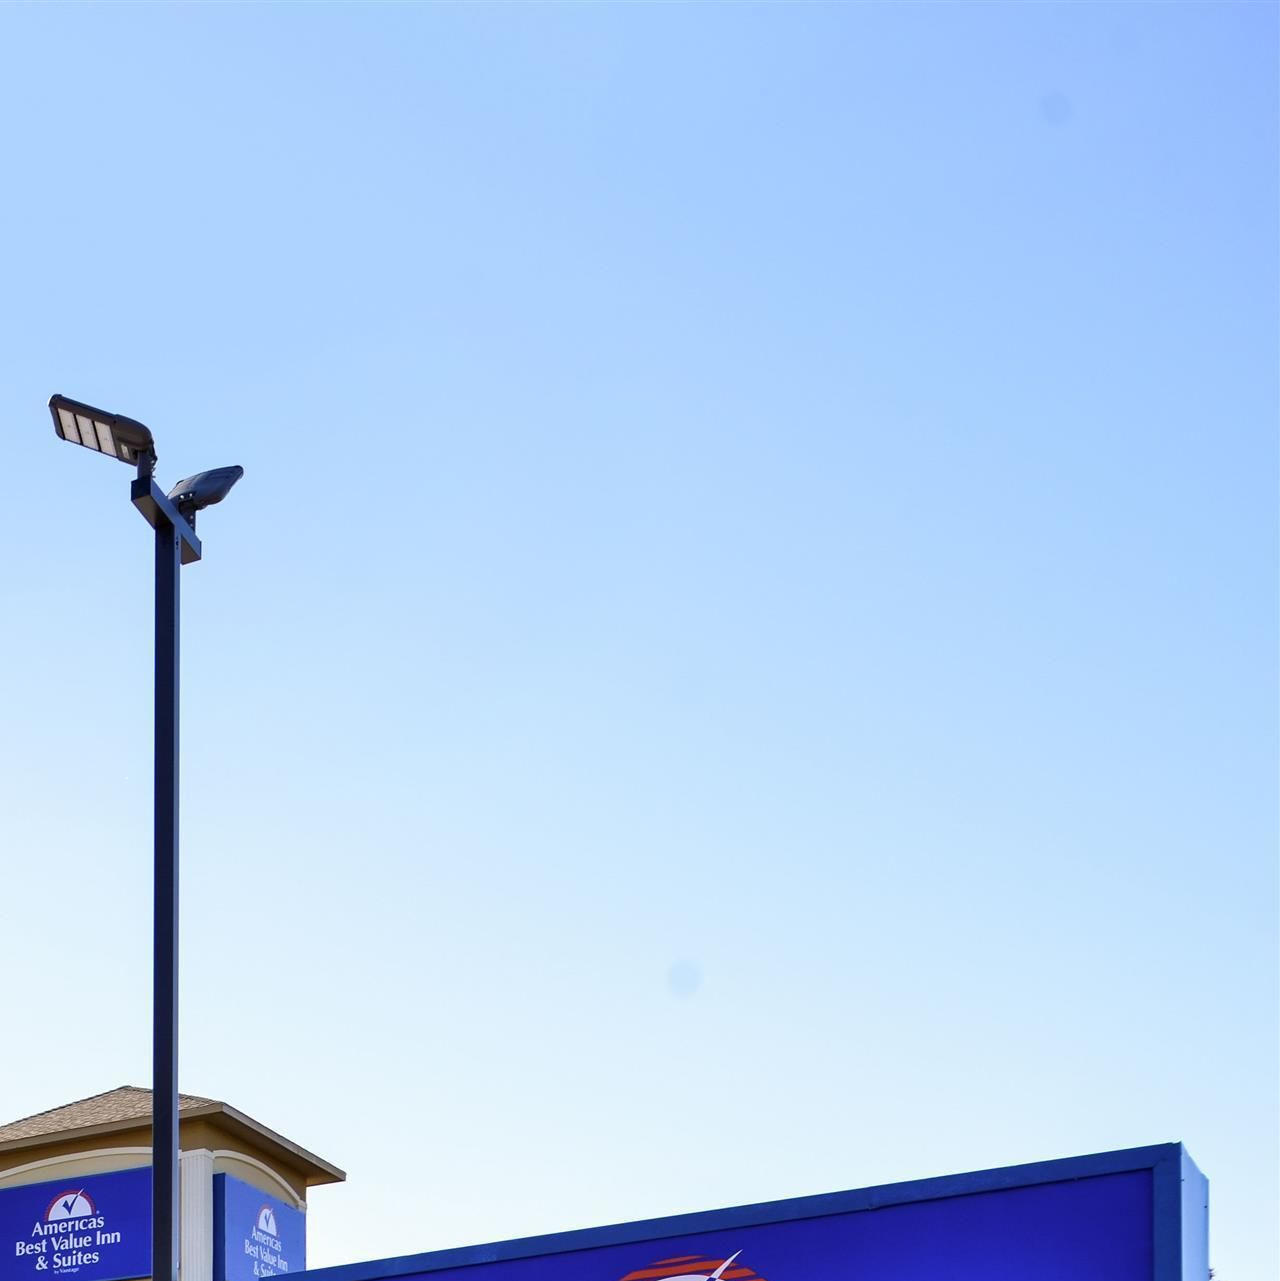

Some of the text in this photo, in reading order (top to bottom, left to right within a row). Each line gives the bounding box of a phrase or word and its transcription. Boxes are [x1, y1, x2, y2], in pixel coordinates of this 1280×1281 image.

[31, 1215, 105, 1237] Americas
[15, 1230, 121, 1257] Best Value Inn
[251, 1225, 282, 1252] Americas
[35, 1250, 100, 1272] & Suites
[244, 1239, 288, 1272] Best Value Inn
[260, 1263, 277, 1277] Suit
